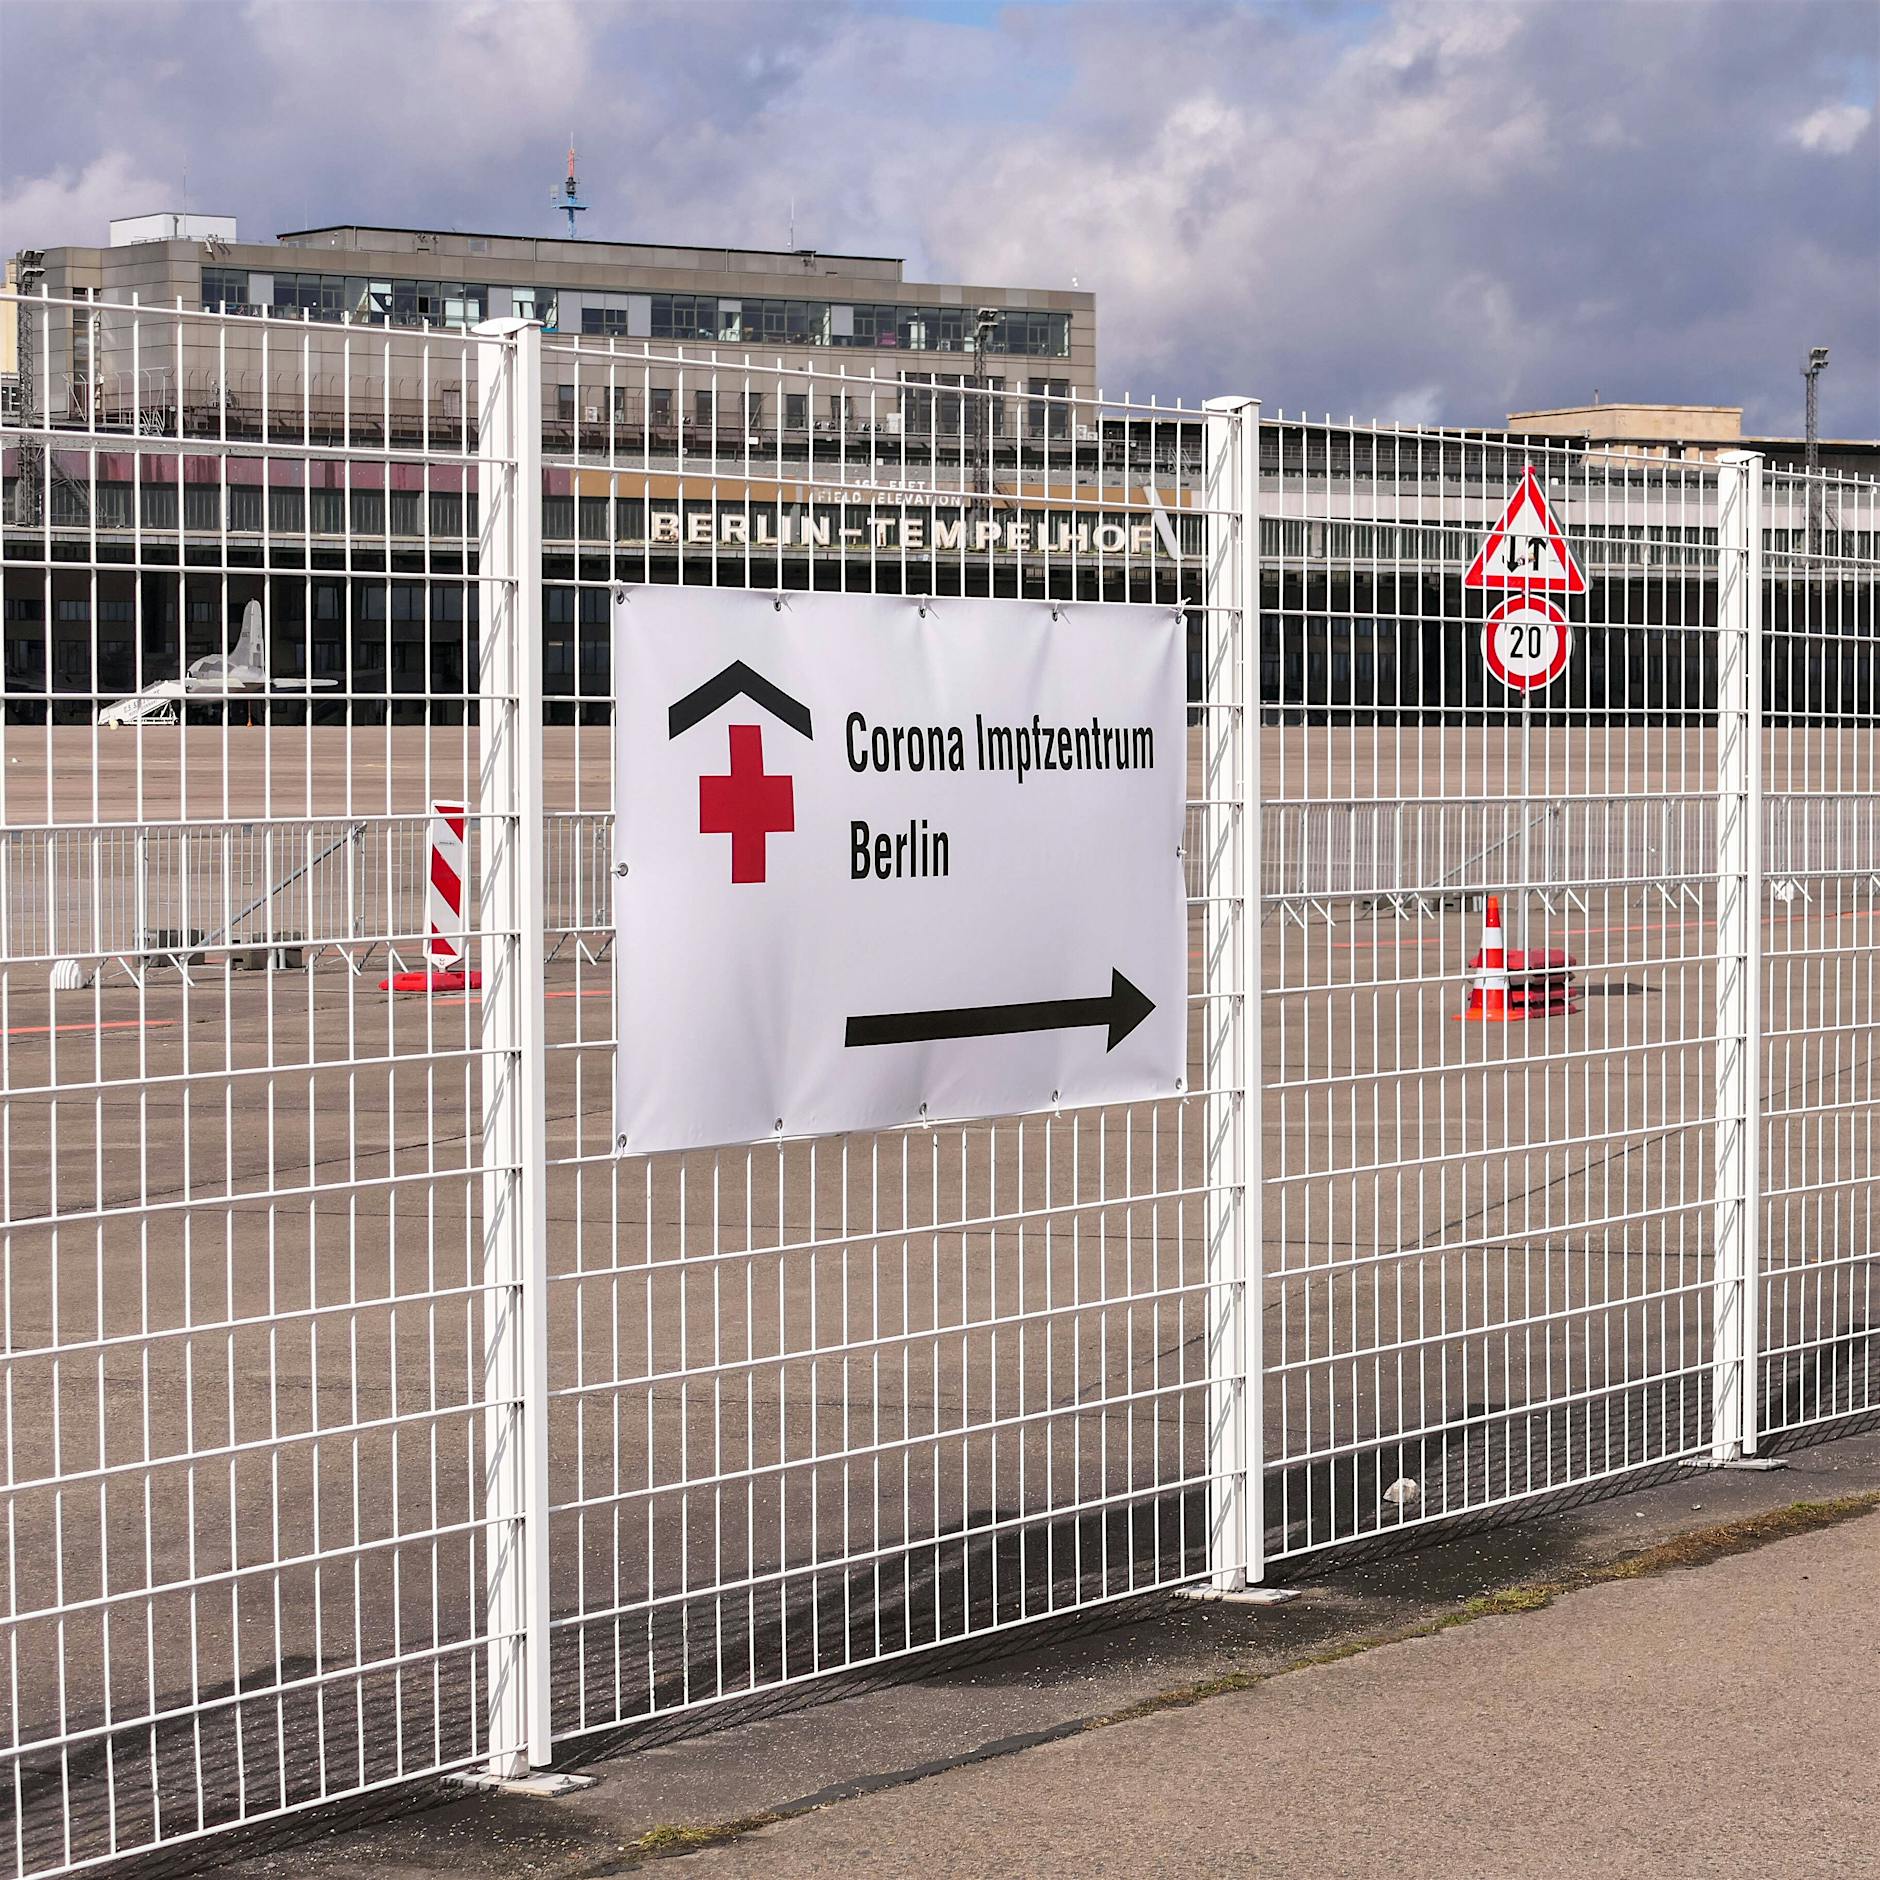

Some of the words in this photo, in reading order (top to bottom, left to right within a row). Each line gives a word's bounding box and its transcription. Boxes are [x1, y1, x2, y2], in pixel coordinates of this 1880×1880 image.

[818, 491, 861, 503] FIELD
[877, 491, 961, 506] ELEVATION
[651, 511, 1153, 554] BERLIN-TEMPELHOF
[1510, 625, 1541, 659] 20
[846, 711, 965, 773] Corona
[975, 713, 1154, 784] Impfzentrum
[850, 819, 949, 880] Berlin
